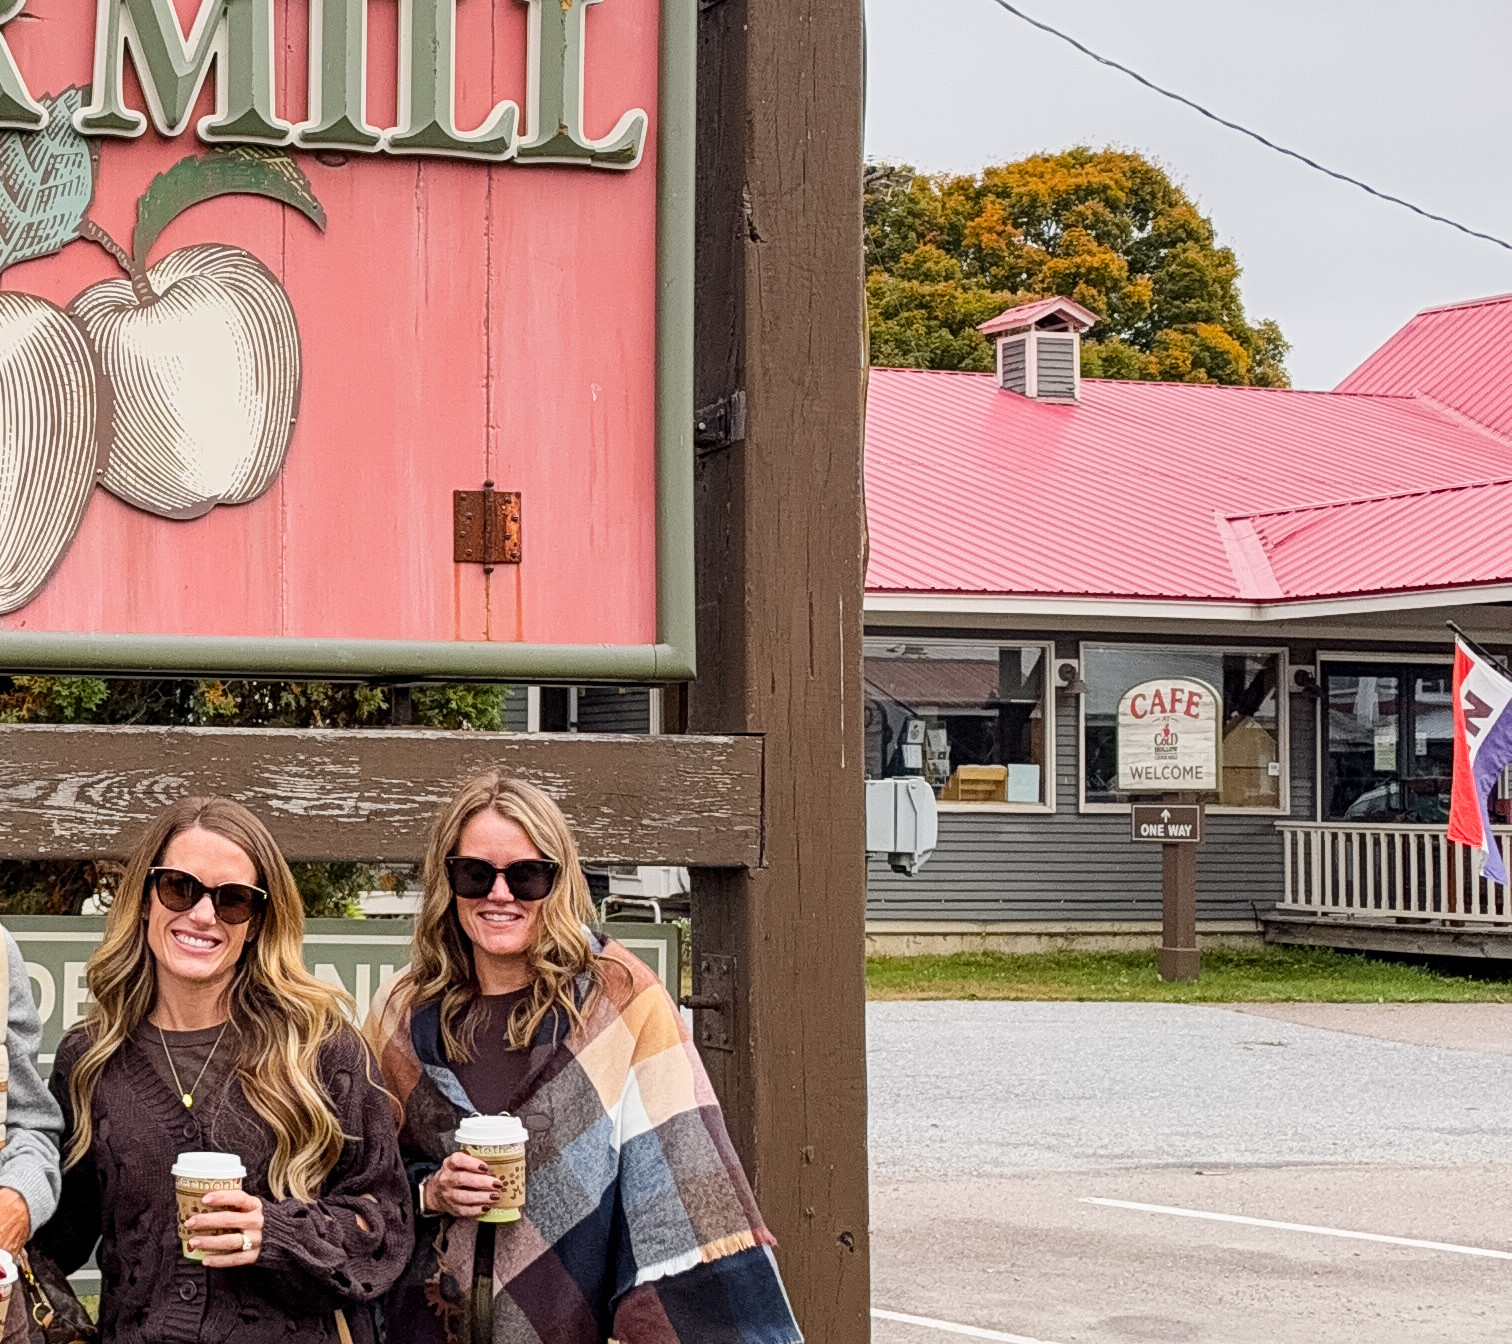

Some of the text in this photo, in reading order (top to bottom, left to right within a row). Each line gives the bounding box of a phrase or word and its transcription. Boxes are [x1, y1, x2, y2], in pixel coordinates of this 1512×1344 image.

[1130, 688, 1203, 719] CAFE
[1130, 765, 1203, 780] WELCOME
[1140, 823, 1193, 837] ONE WAY
